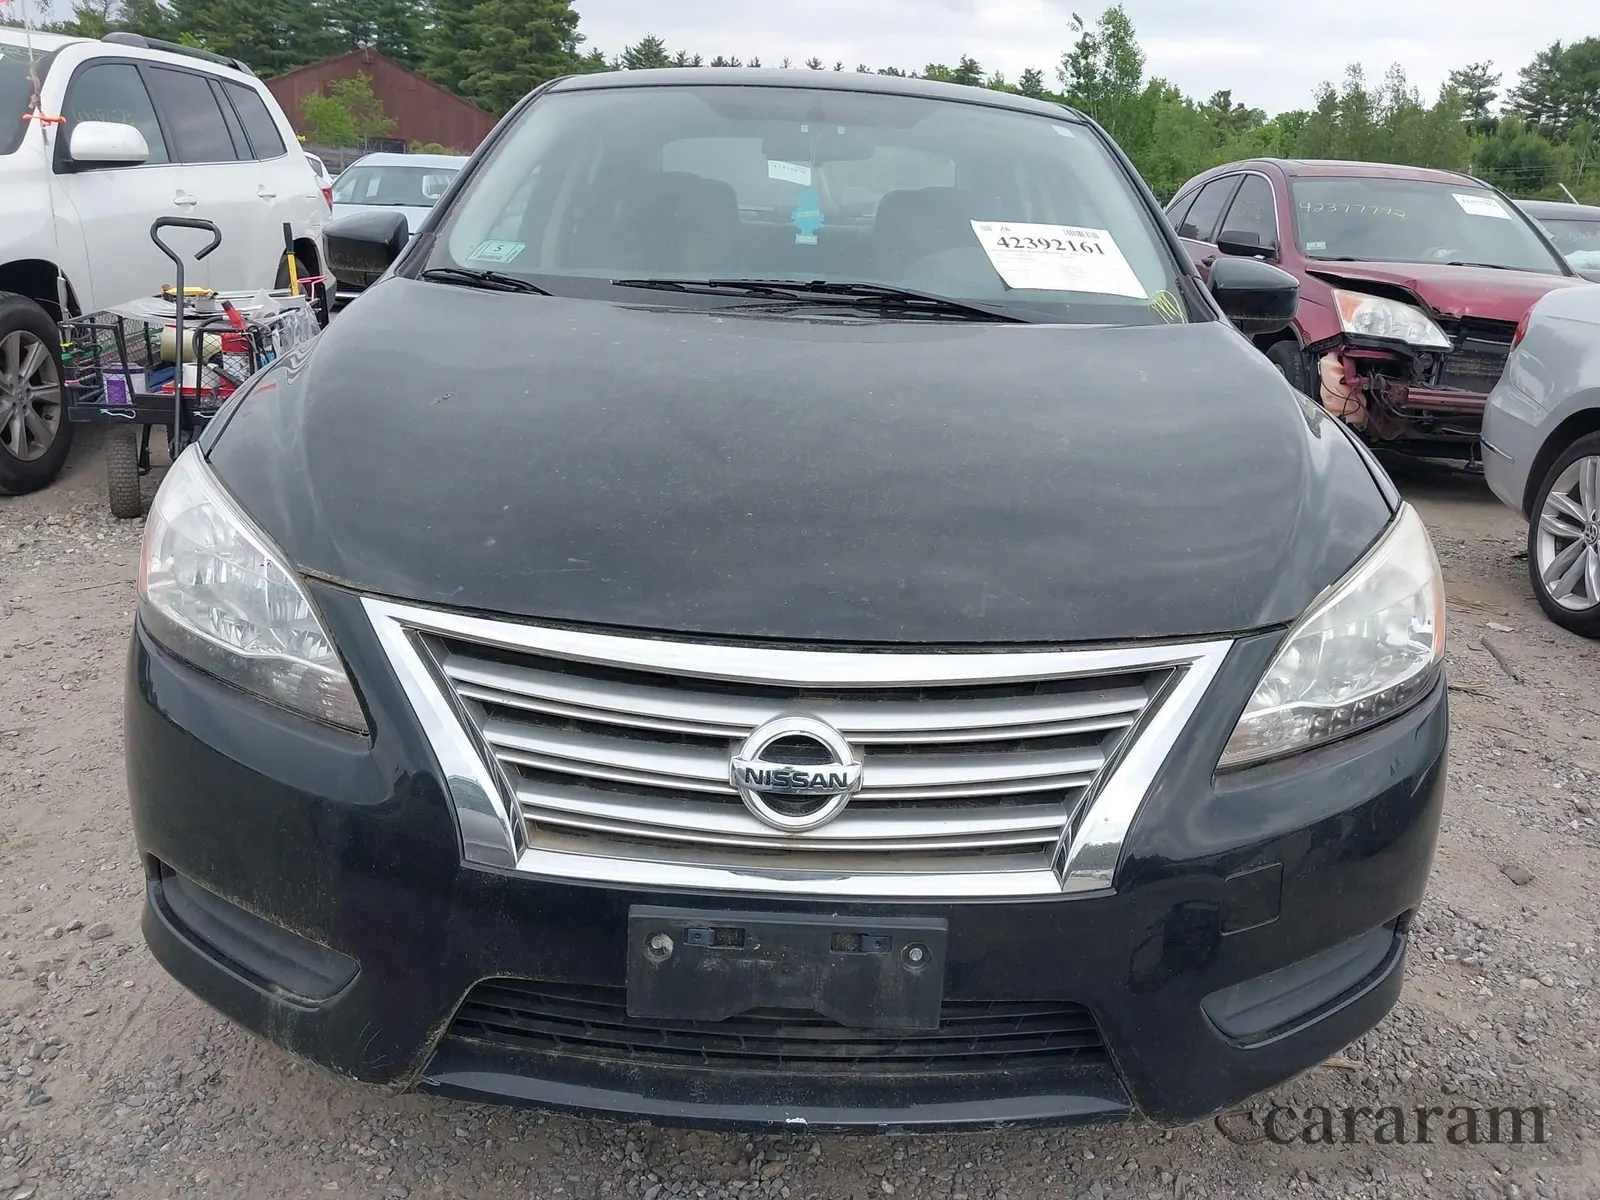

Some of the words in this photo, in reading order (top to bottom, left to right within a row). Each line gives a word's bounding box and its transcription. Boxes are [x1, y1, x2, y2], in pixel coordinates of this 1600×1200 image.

[1299, 202, 1407, 219] 42377792
[997, 236, 1106, 255] 42392161
[744, 767, 848, 789] NISSAN
